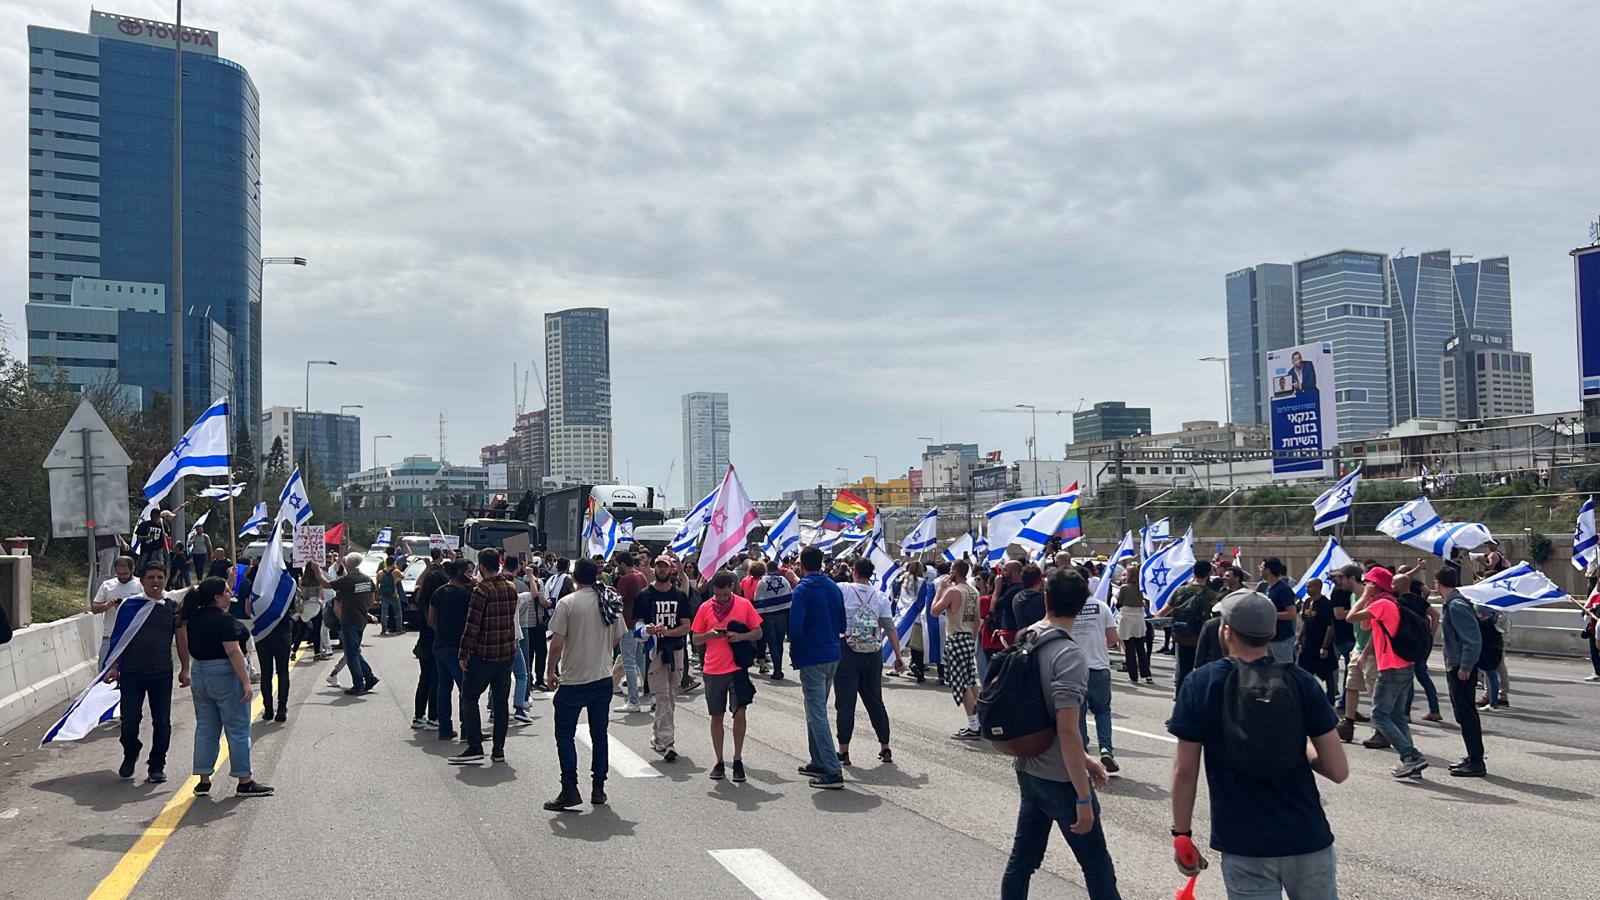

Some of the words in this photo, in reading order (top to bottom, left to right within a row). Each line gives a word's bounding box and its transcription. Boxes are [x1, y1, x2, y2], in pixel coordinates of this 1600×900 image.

[146, 25, 213, 47] TOYOTA
[1287, 411, 1318, 423] בנקאי
[1294, 423, 1317, 434] בזום
[1282, 435, 1318, 448] השירות
[655, 600, 678, 613] דמו
[656, 613, 677, 627] קרט
